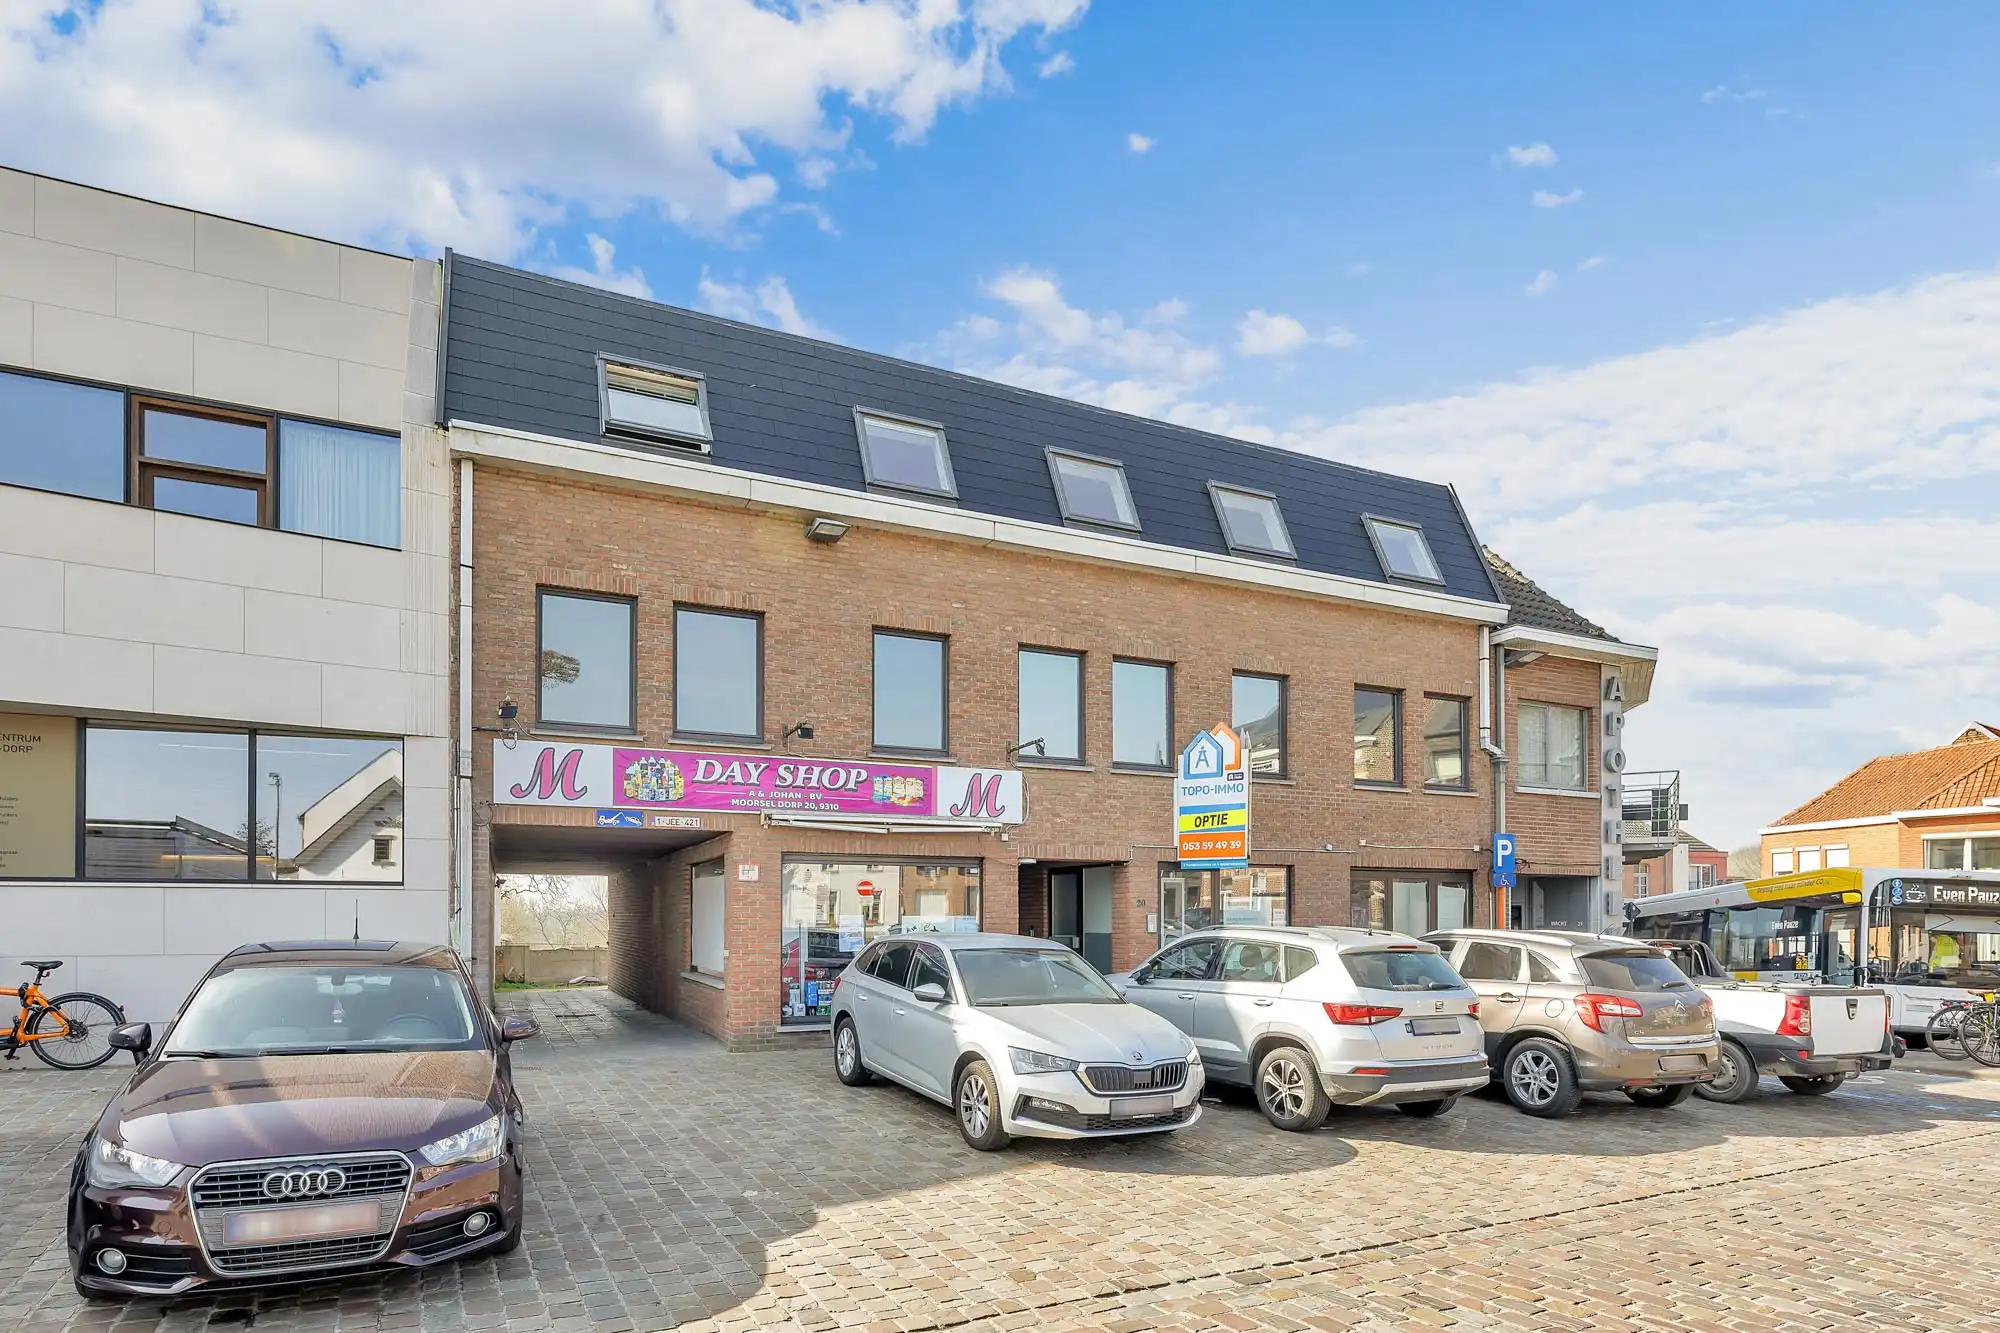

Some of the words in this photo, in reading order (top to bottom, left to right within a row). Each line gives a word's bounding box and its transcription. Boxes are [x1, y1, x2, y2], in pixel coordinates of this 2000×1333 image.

[510, 747, 588, 800] M
[692, 759, 769, 787] DAY
[775, 763, 868, 791] SHOP
[769, 791, 801, 799] JOHAN
[950, 772, 1005, 818] M
[1181, 783, 1244, 796] TOPO-IMMO
[731, 798, 775, 808] MOORSEL
[778, 800, 803, 809] DORP
[804, 801, 818, 811] 20,
[819, 802, 839, 811] 9310
[1194, 813, 1228, 828] OPTIE
[1182, 841, 1200, 851] 053
[1202, 841, 1213, 850] 59
[1215, 841, 1227, 850] 49
[1229, 840, 1241, 849] 39
[1497, 839, 1513, 867] P
[1934, 885, 1965, 903] Even
[1784, 920, 1799, 929] Pauze
